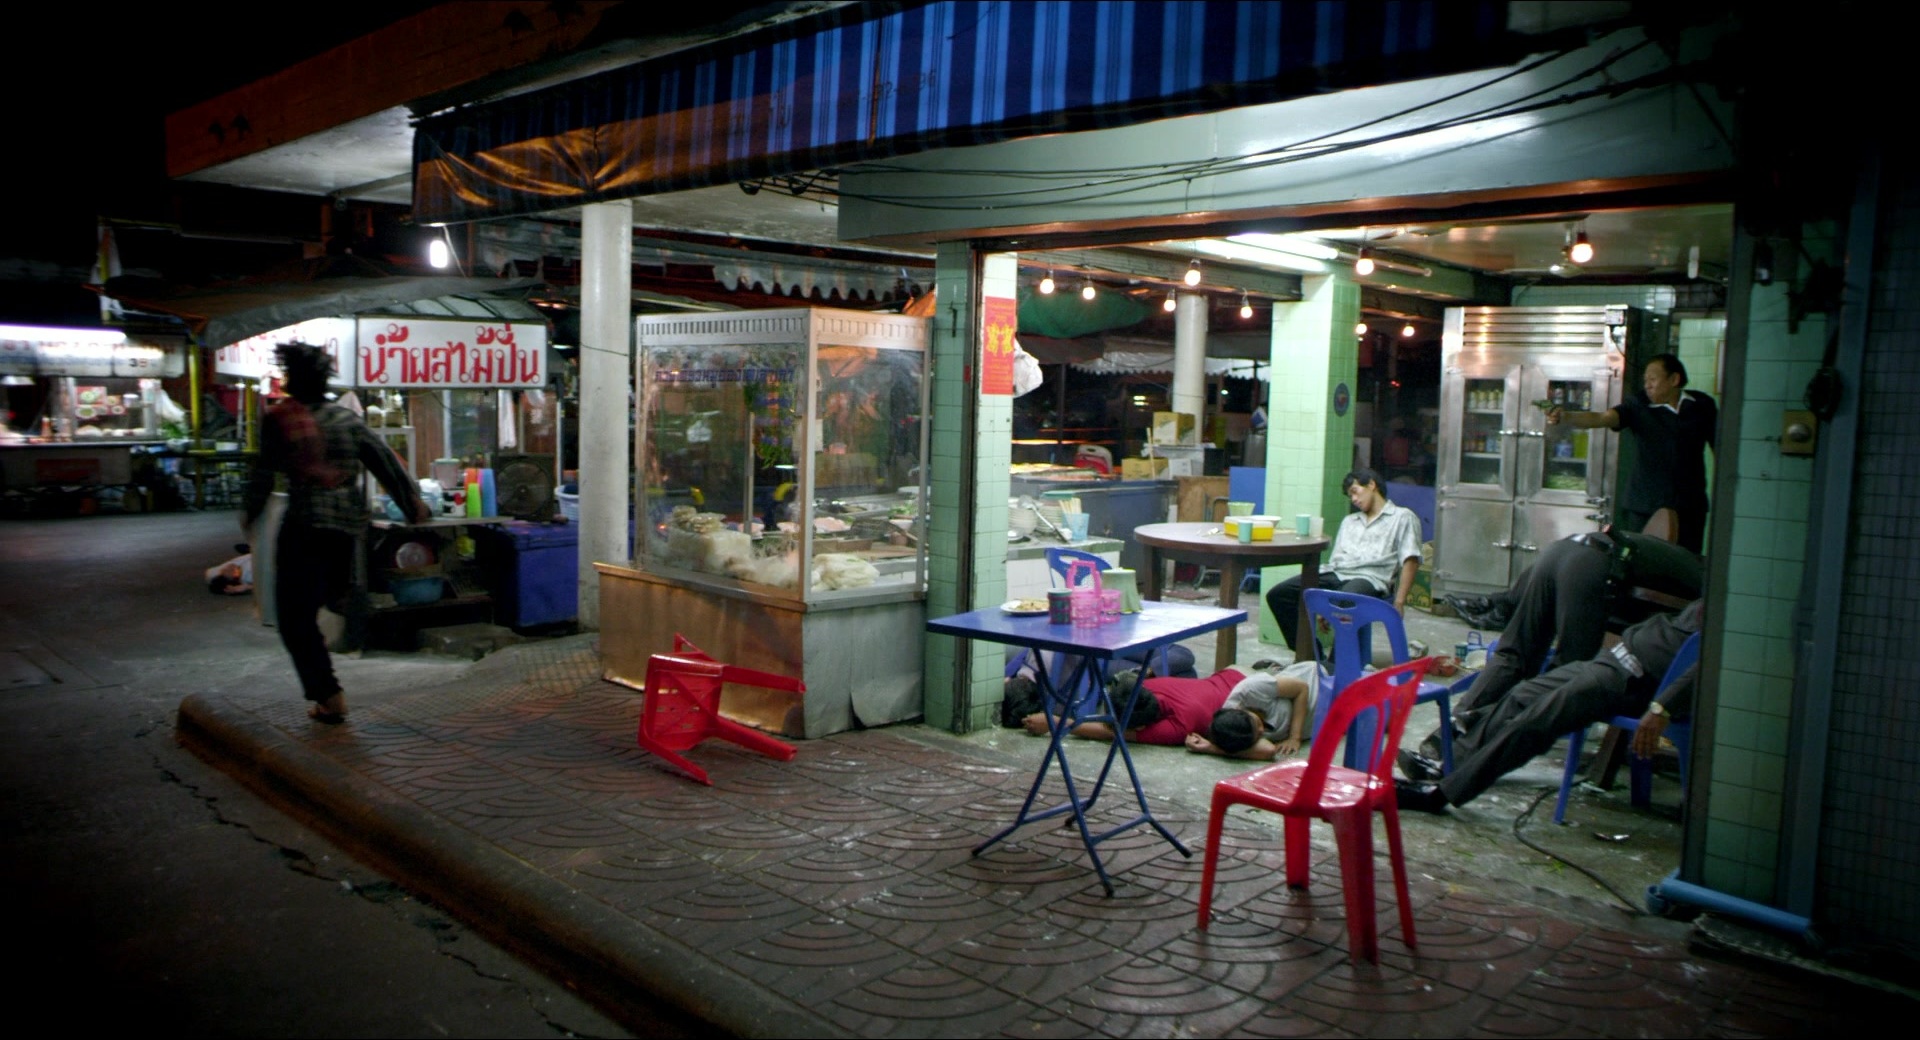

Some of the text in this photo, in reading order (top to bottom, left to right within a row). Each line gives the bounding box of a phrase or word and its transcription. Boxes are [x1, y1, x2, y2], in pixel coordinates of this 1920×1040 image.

[359, 322, 541, 384] น้ำผลไม้ปั่น
